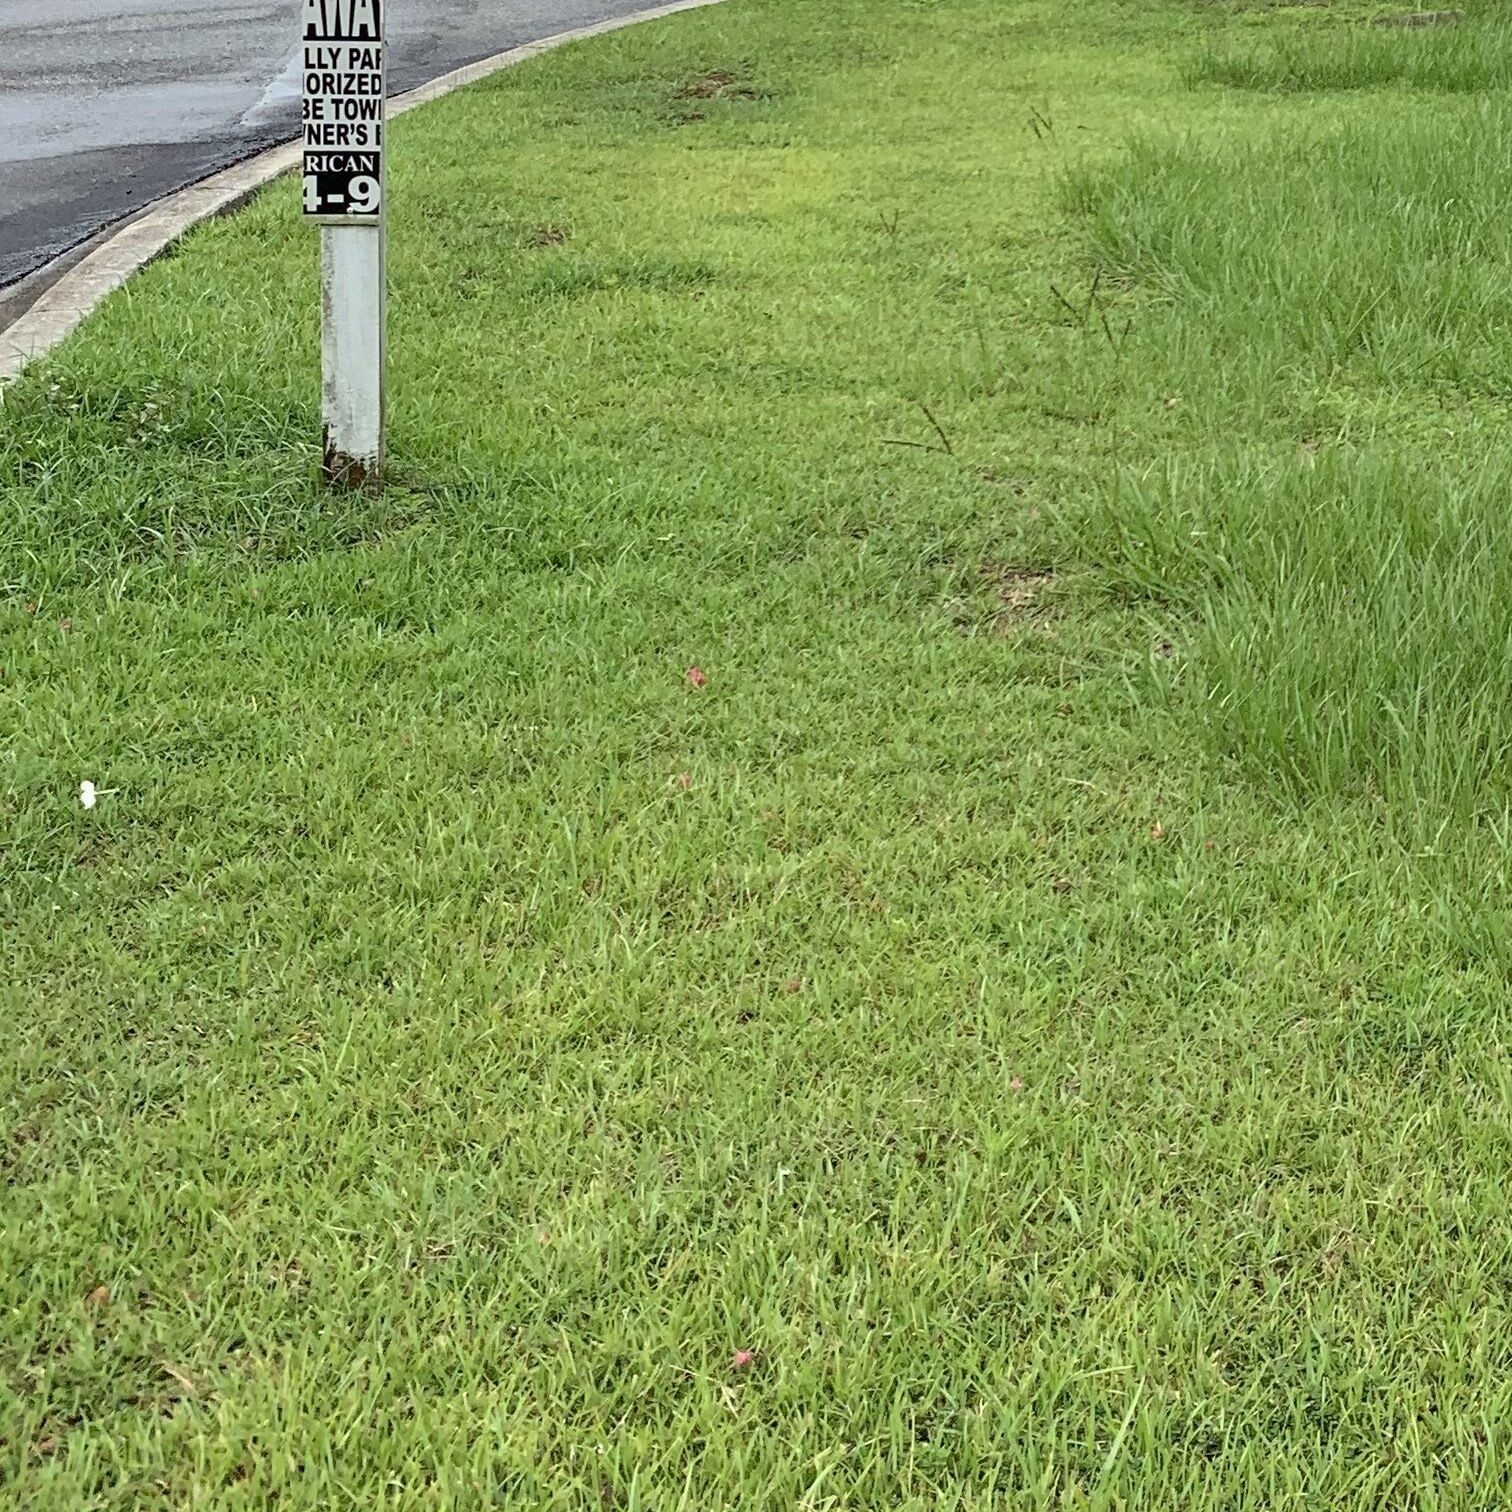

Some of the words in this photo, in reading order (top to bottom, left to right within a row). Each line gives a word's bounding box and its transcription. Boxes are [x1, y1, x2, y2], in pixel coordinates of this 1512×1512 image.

[305, 47, 342, 69] LLY
[306, 73, 381, 95] ORIZED
[331, 98, 381, 121] TOW
[303, 123, 368, 146] NER'S
[305, 154, 374, 172] RICAN
